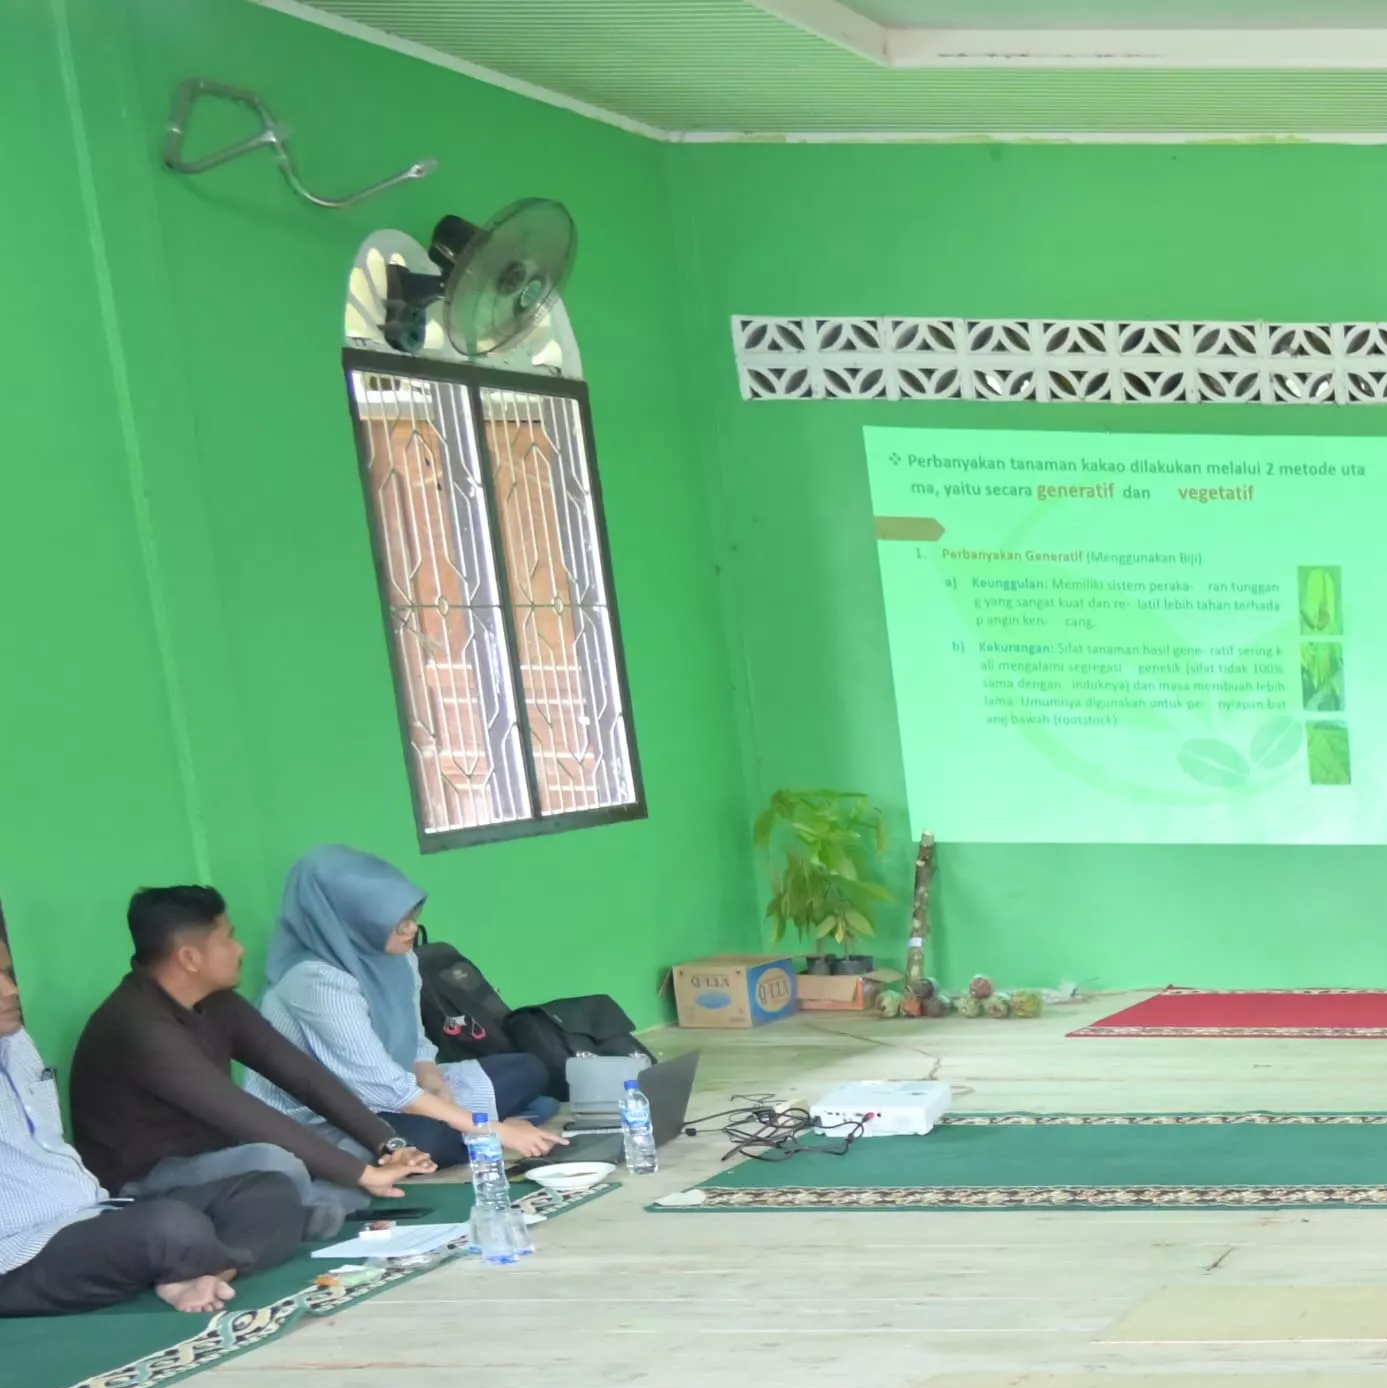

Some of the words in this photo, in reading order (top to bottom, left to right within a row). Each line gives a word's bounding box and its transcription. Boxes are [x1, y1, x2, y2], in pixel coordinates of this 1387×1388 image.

[906, 453, 1006, 472] Perbanyakan
[1010, 457, 1077, 472] tanaman
[1081, 458, 1126, 473] kakao
[1130, 459, 1202, 474] dilakukan
[1206, 460, 1261, 476] melalui
[1265, 461, 1275, 476] 2
[1279, 461, 1337, 477] metode
[1341, 463, 1367, 477] uta
[910, 482, 940, 498] ma,
[944, 480, 982, 498] yaitu
[985, 484, 1033, 498] secara
[1035, 480, 1116, 502] generatif
[1123, 485, 1151, 500] dan
[1177, 484, 1256, 504] vegetatif
[941, 548, 1022, 563] Perbanyakan
[1025, 549, 1083, 563] Generatif
[944, 576, 958, 590] a)
[972, 577, 1049, 592] Keunggulan:
[1106, 579, 1146, 592] sistem
[1208, 581, 1228, 593] ran
[1231, 580, 1280, 596] tunggan
[1088, 598, 1111, 610] dan
[952, 640, 965, 655] b)
